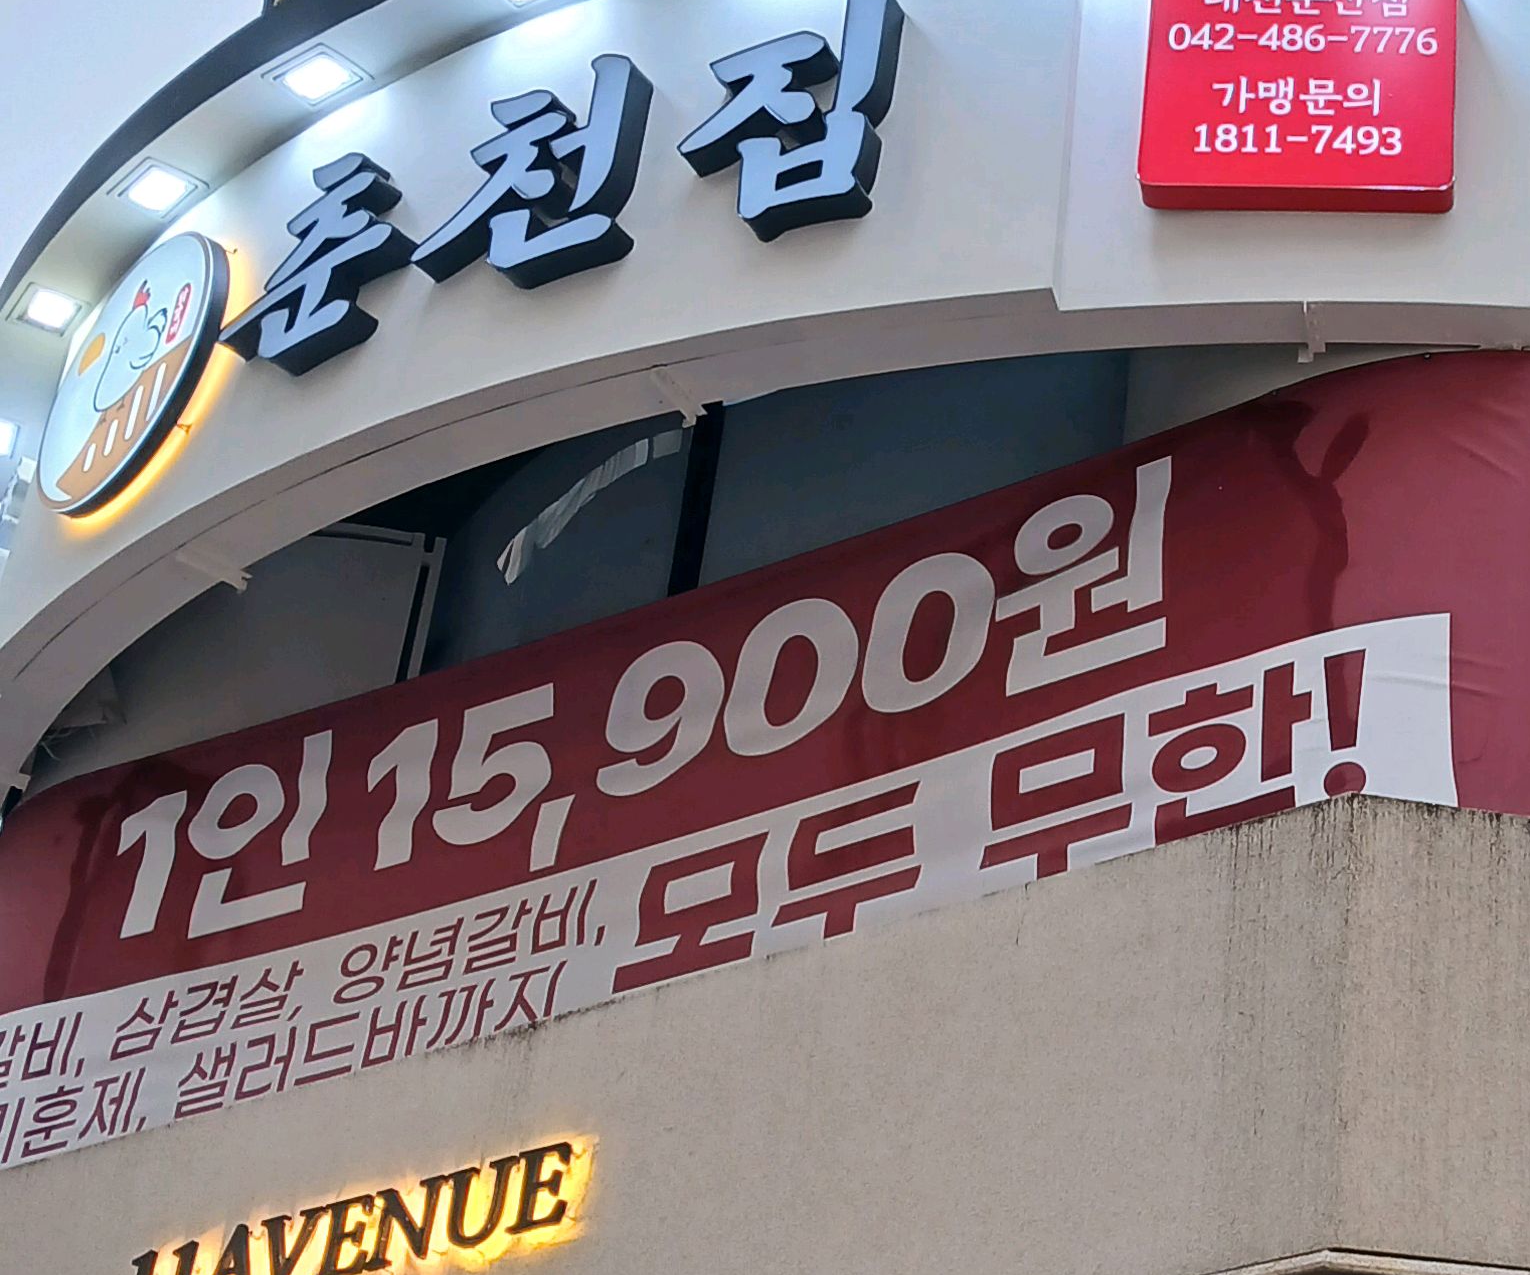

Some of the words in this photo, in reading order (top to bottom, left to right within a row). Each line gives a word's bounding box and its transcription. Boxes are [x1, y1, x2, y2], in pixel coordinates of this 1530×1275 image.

[1168, 21, 1439, 56] 042-486-7776
[1212, 75, 1382, 116] 가맹문의
[1194, 122, 1403, 156] 1811-7493
[117, 730, 333, 939] 1인
[367, 455, 1173, 872] 15,900원
[611, 780, 923, 994] 모두
[980, 648, 1368, 878] 무한!
[110, 960, 304, 1062] 삼겹살,
[333, 878, 607, 1007] 양념갈비,
[174, 960, 568, 1120] 샐러드바까지
